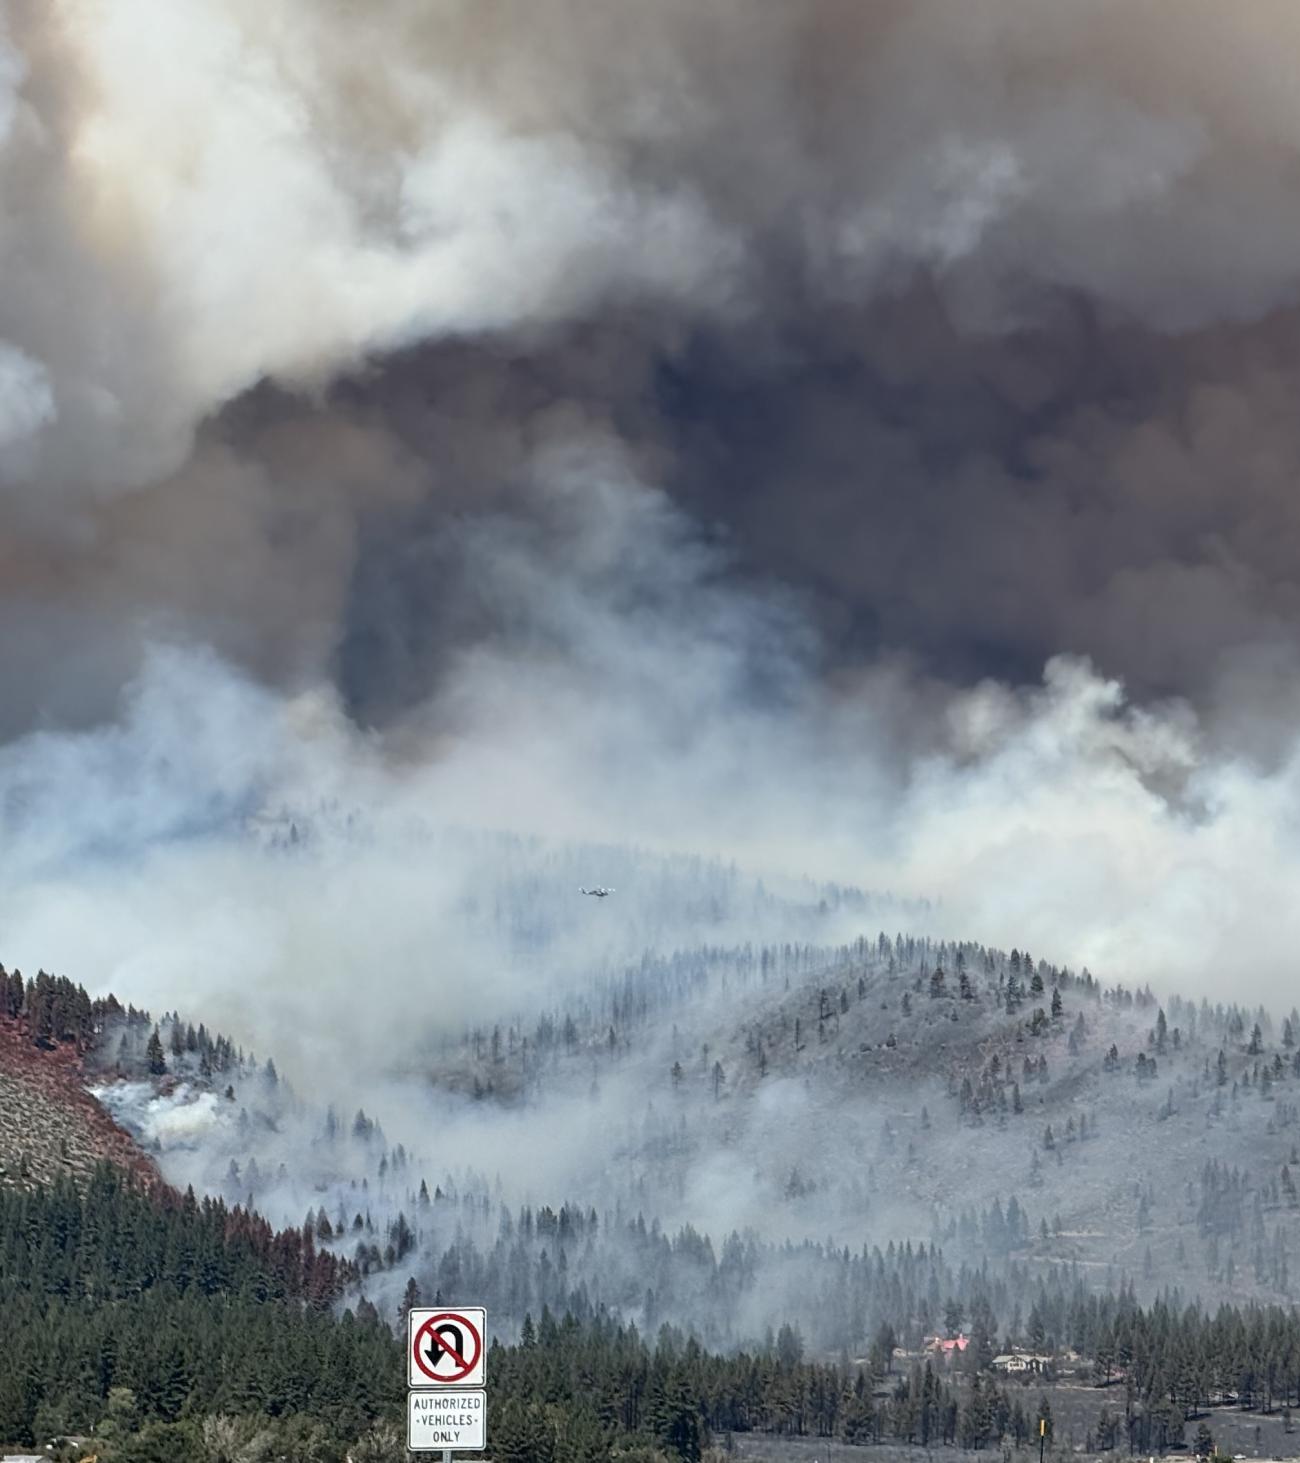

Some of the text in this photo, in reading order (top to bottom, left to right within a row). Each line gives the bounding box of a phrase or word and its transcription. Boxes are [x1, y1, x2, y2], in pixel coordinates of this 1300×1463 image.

[414, 1398, 481, 1409] AUTHORIZED
[422, 1415, 472, 1425] VEHICLES
[433, 1431, 460, 1442] ONLY
